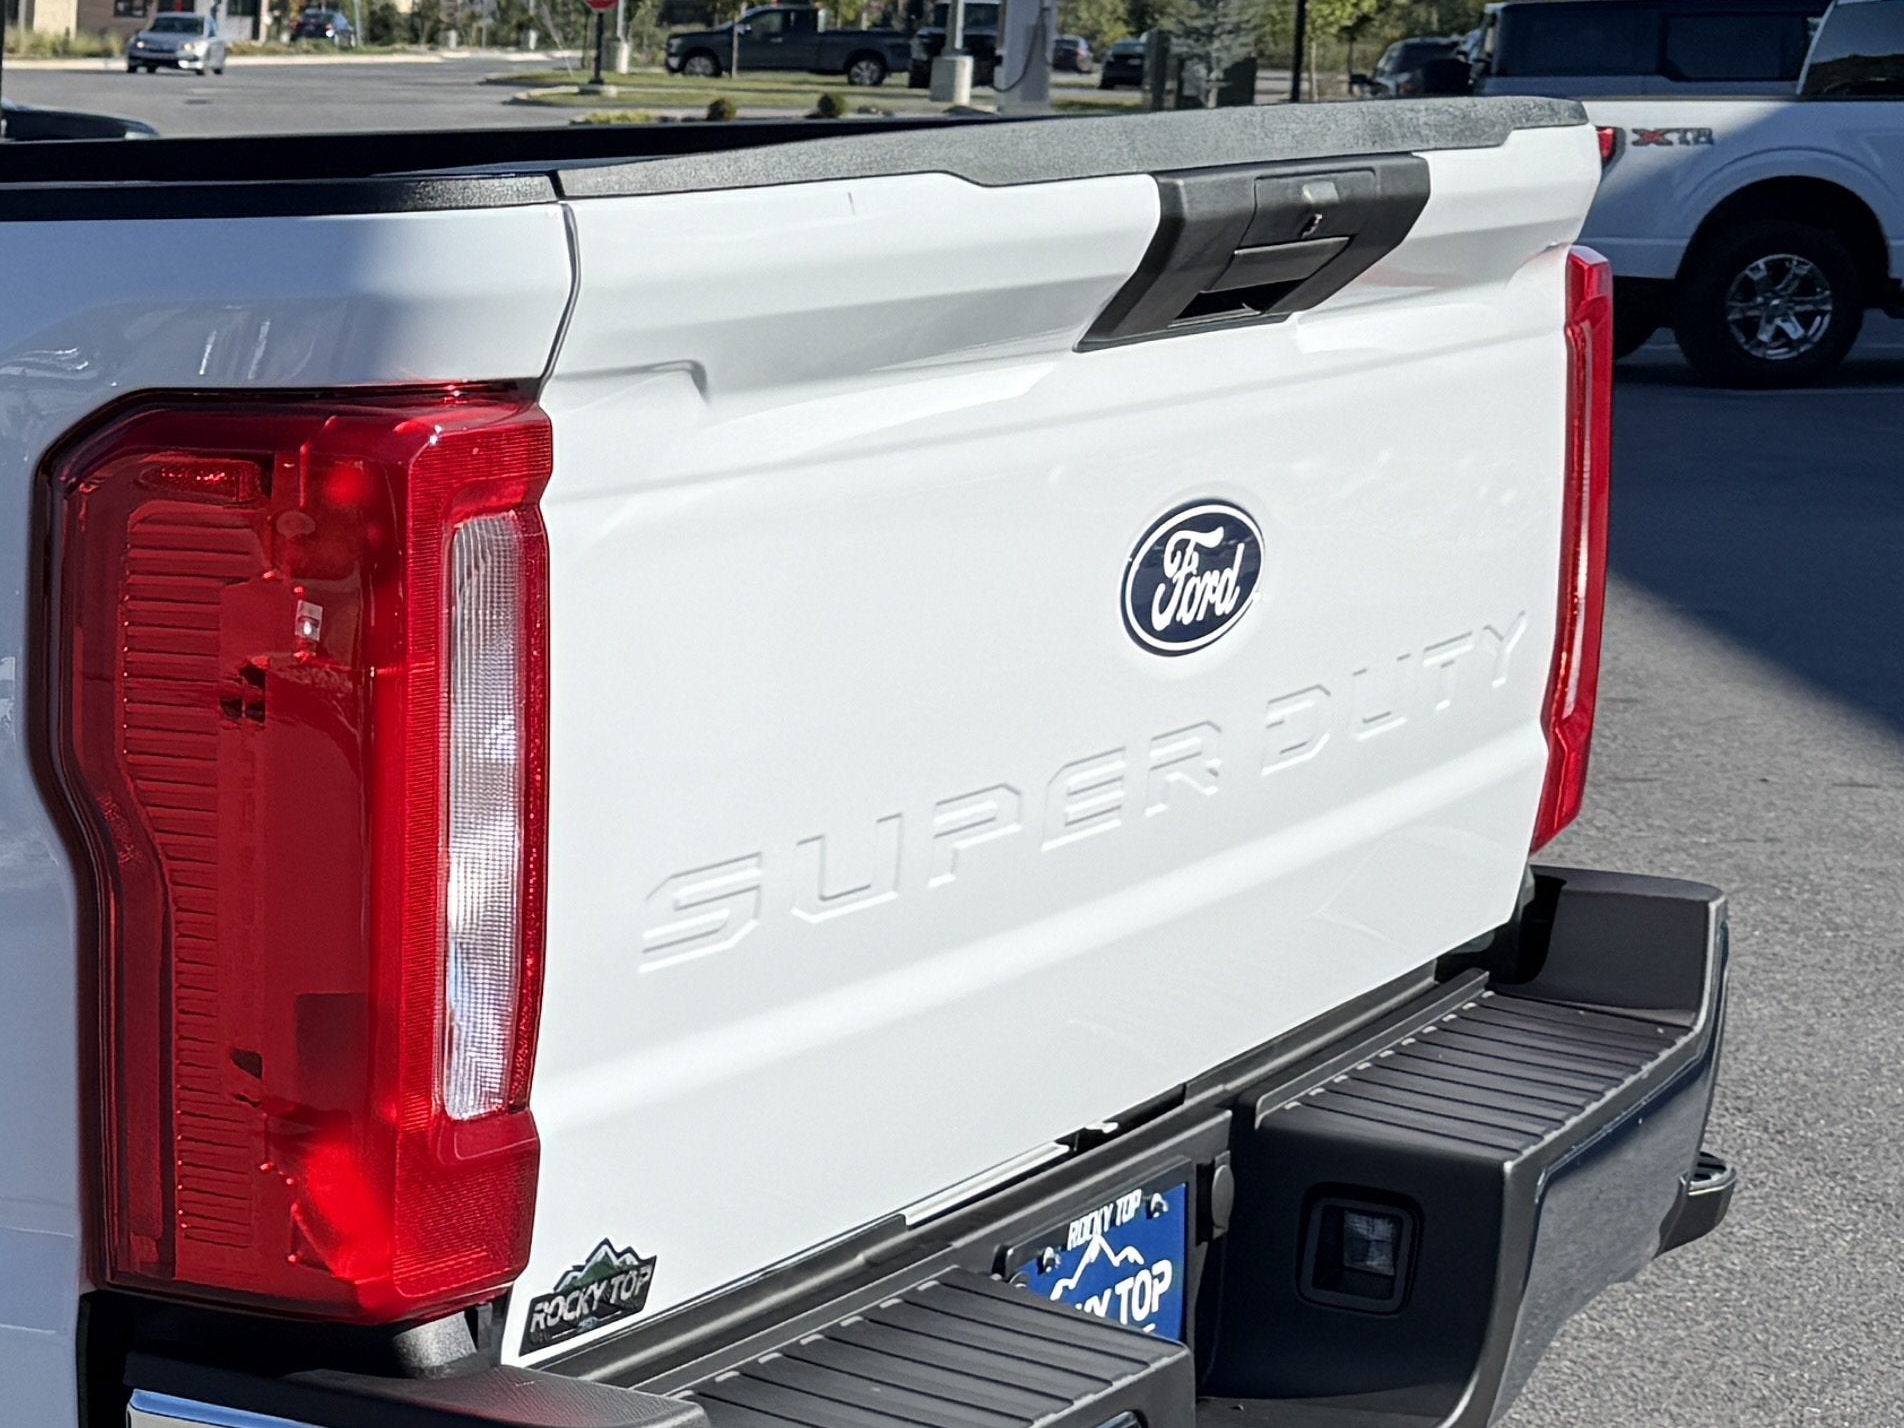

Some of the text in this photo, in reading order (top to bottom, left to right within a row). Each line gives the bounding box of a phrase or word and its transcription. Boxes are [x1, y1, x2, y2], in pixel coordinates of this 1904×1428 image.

[1150, 525, 1246, 632] Ford
[638, 610, 1528, 973] SUPER DUTY
[1066, 1188, 1143, 1252] ROCKY TOP
[529, 1264, 654, 1334] ROCKY TOP
[1114, 1258, 1173, 1326] TOP
